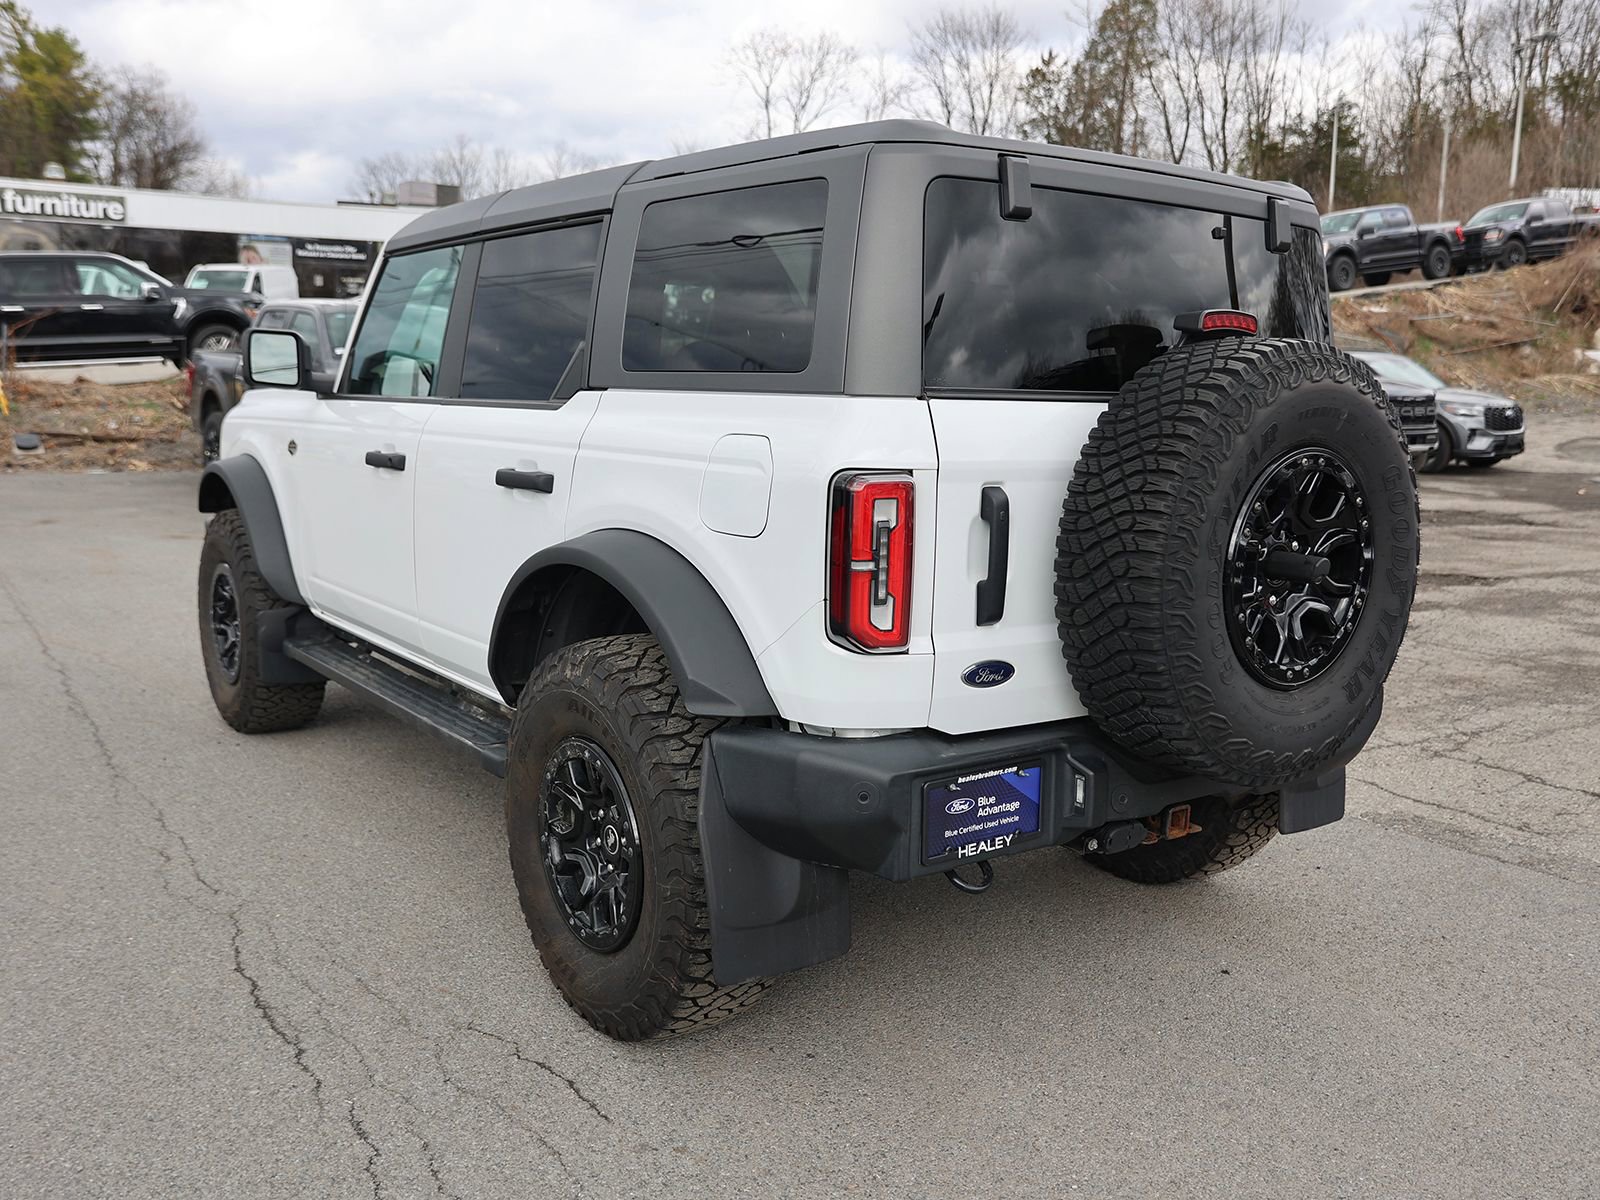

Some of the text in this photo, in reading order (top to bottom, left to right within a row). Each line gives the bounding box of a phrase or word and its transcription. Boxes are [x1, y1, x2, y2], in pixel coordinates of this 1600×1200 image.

[2, 188, 126, 221] furniture
[957, 766, 1018, 784] healeybrothers.com
[977, 796, 996, 807] Blue
[977, 801, 1020, 817] Advantage
[944, 815, 1020, 838] Blue Certified Used Vehicle
[958, 834, 1014, 859] HEALEY
